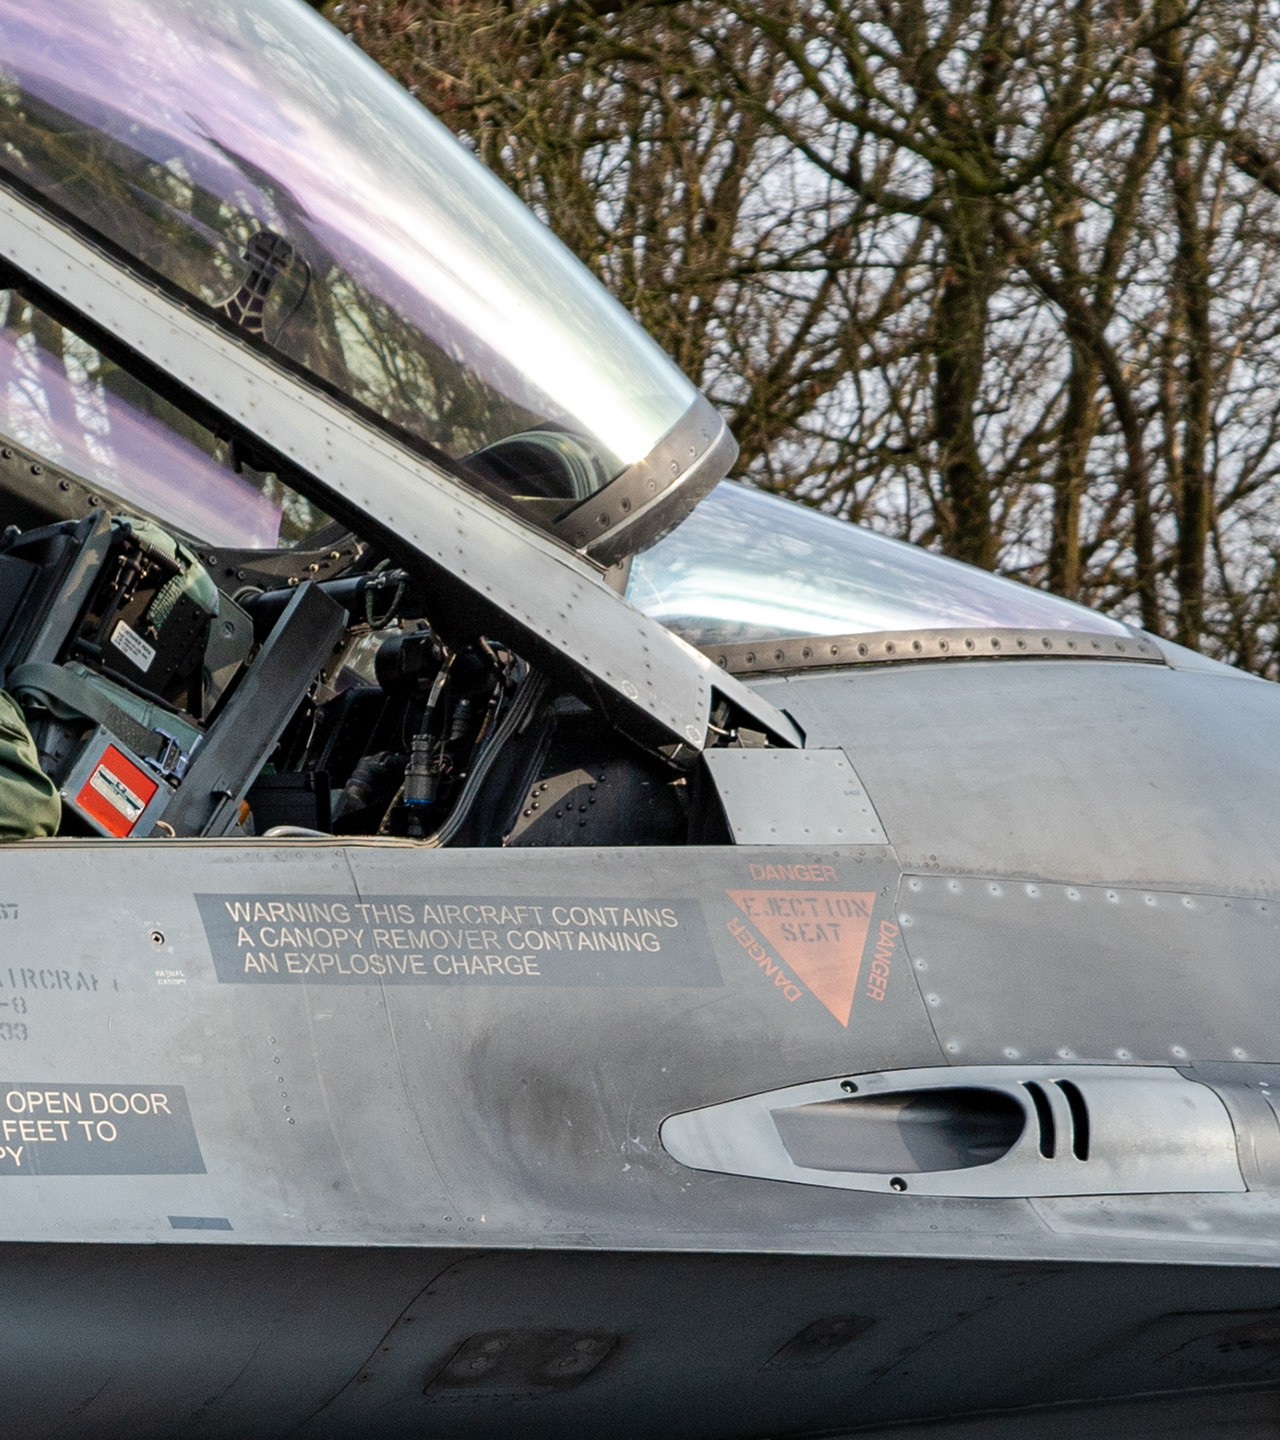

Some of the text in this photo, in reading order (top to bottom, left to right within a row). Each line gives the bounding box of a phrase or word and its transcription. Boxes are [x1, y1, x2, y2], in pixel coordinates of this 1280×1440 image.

[748, 864, 839, 882] DANGER
[225, 902, 679, 928] WARNING THIS AIRCRAFT CONTAINS
[742, 897, 871, 918] EJECTION
[236, 926, 661, 952] A CANOPY REMOVER CONTAINING
[781, 922, 841, 943] SEAT
[244, 952, 541, 976] AN EXPLOSIVE CHARGE
[725, 917, 803, 1002] DANGER
[866, 920, 899, 1002] DANGER
[6, 1091, 84, 1114] OPEN
[89, 1092, 172, 1115] DOOR
[3, 1120, 73, 1142] FEET
[78, 1120, 118, 1142] TO
